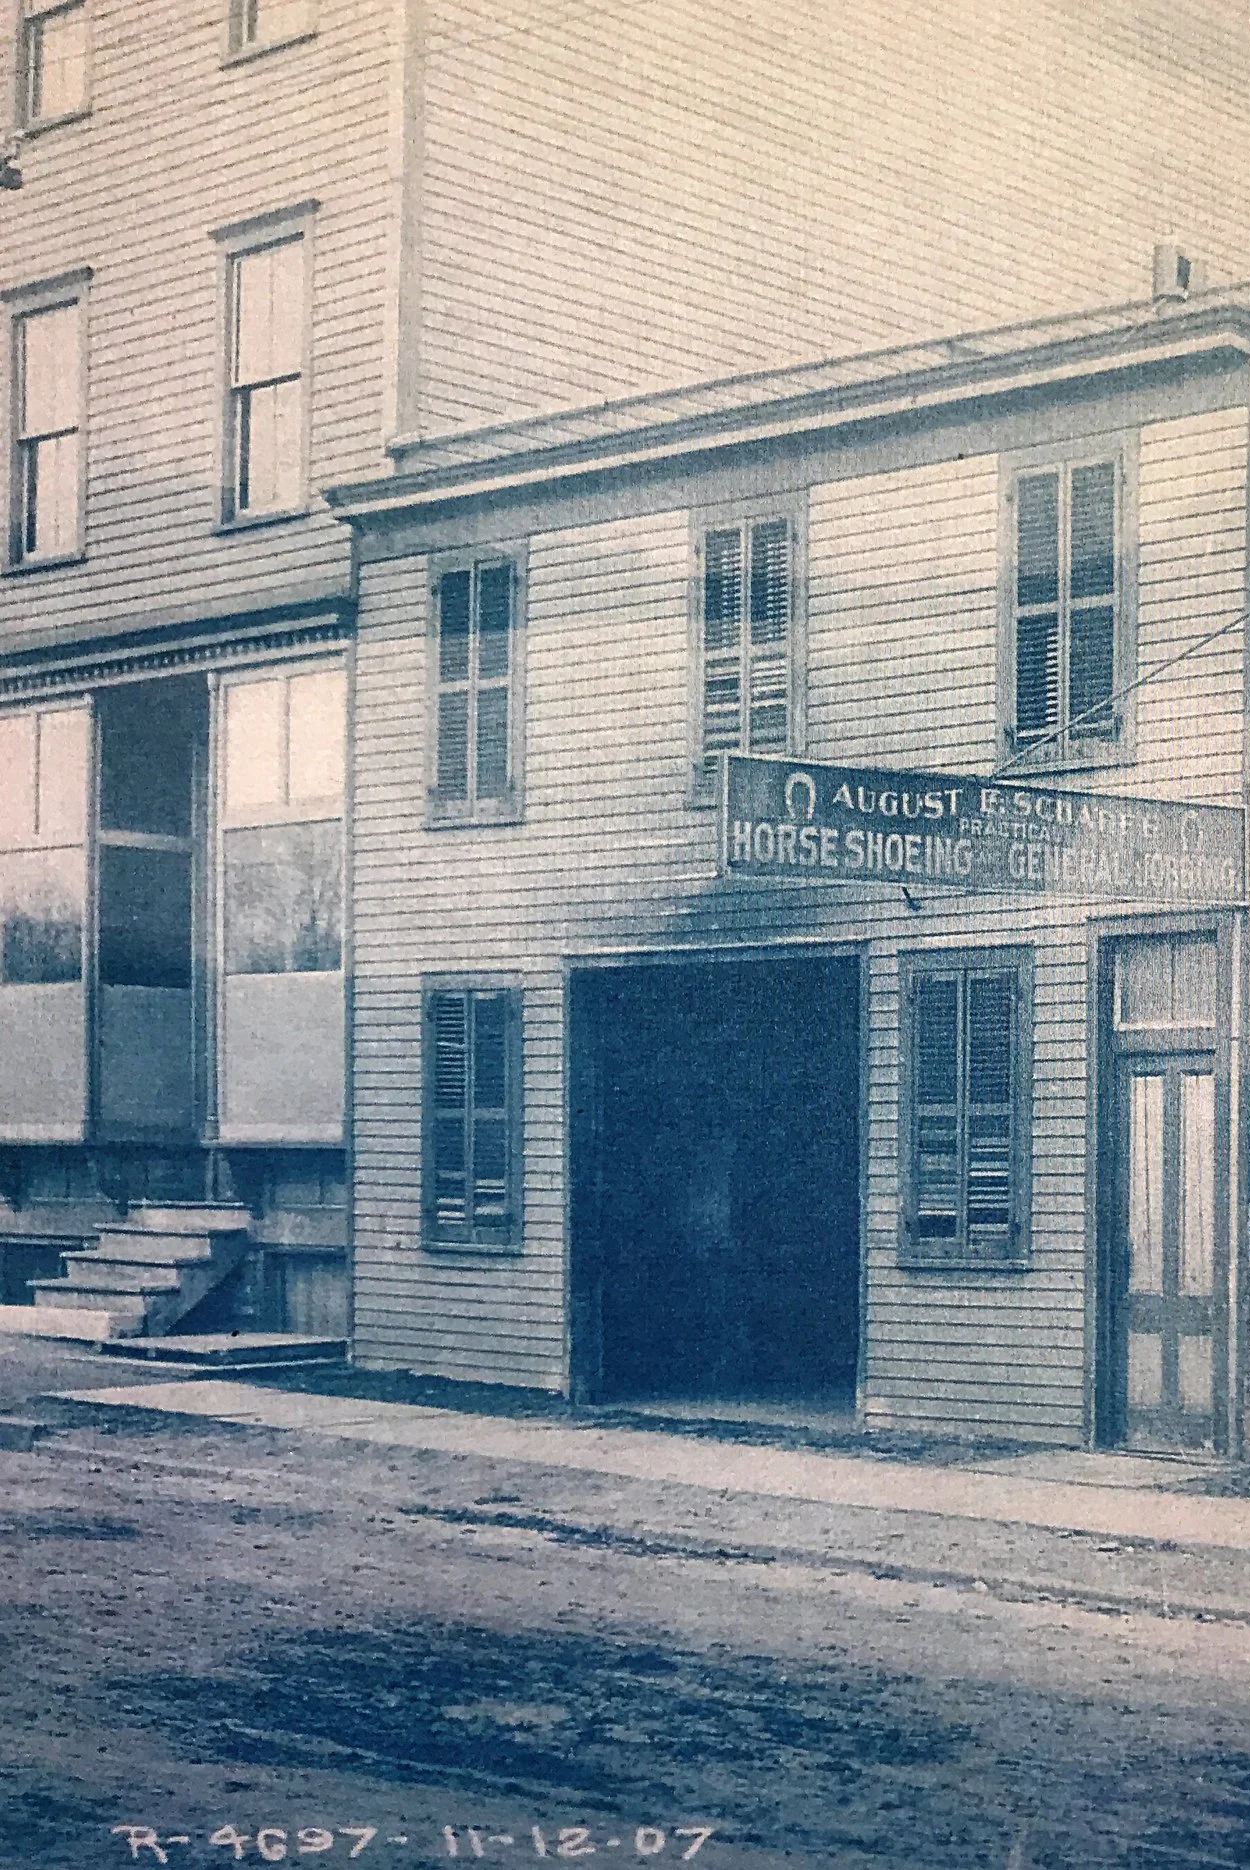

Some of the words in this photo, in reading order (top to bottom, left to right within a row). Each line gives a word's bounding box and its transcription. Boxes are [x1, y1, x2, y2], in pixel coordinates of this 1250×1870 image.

[832, 782, 964, 820] AUGUST
[733, 820, 839, 868] HORSE
[844, 829, 972, 876] SHOEING
